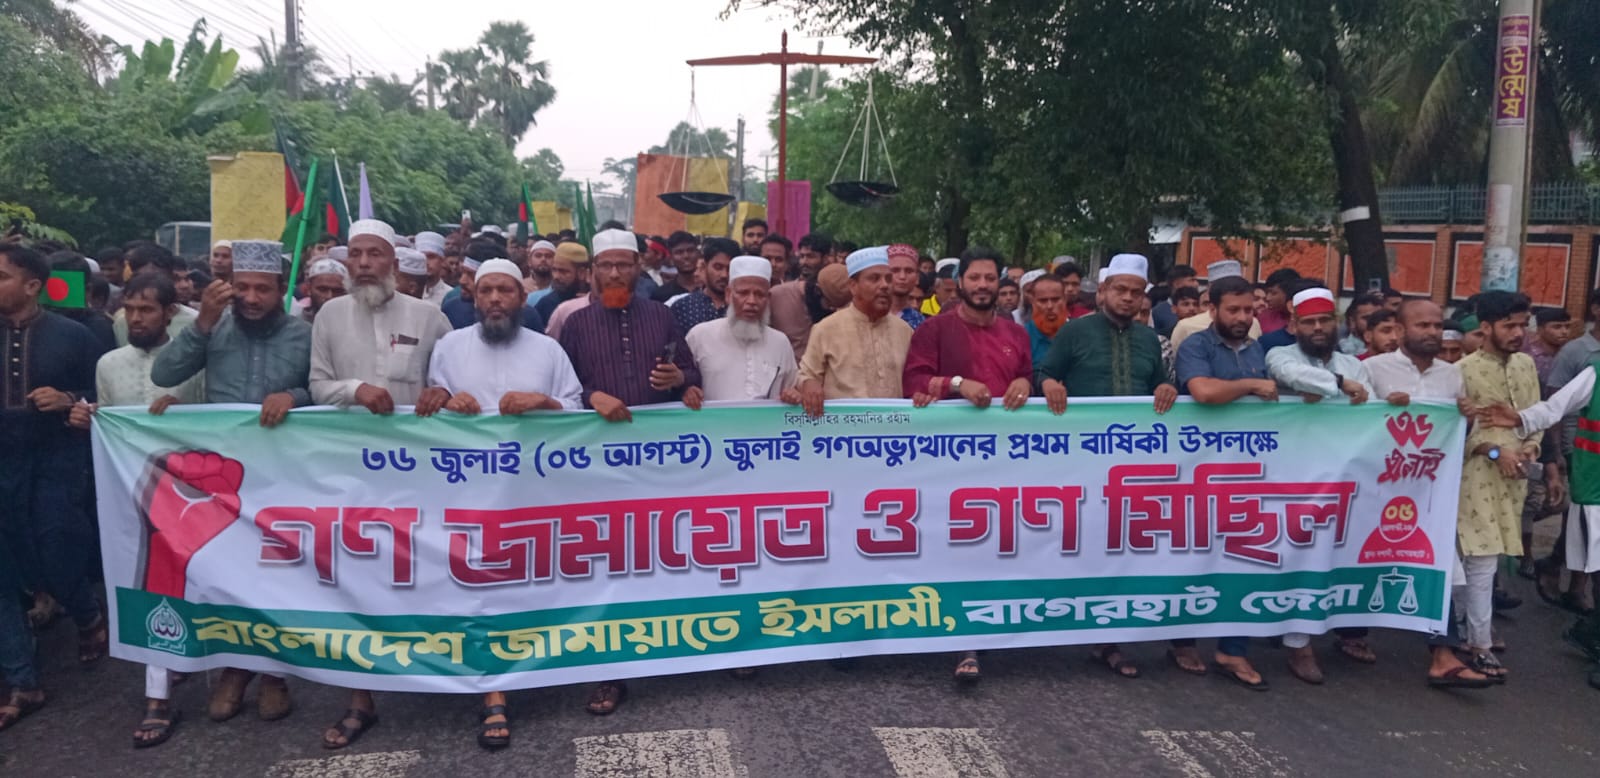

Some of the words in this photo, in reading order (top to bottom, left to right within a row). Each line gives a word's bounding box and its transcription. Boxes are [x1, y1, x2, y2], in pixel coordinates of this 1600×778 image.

[362, 447, 416, 472] ৩৬
[431, 441, 521, 484] জুলাই
[534, 442, 591, 477] (০৫
[603, 434, 712, 470] আগস্ট)
[724, 430, 801, 472] জুলাই
[812, 433, 997, 467] গণঅভ্যুত্থানের
[1008, 431, 1070, 461] প্রথম
[1081, 423, 1168, 455] বার্ষিকী
[1179, 424, 1279, 457] উপলক্ষে
[255, 505, 420, 586] গণ
[444, 490, 830, 586] জমায়েত
[856, 488, 919, 556] ও
[948, 485, 1083, 555] গণ
[1102, 462, 1358, 566] মিছিল
[1385, 504, 1414, 521] ০৫
[192, 616, 466, 668] বাংলাদেশ
[488, 610, 741, 661] জামায়াতে
[759, 586, 956, 638] ইসলামী,
[963, 585, 1220, 625] বাগেরহাট
